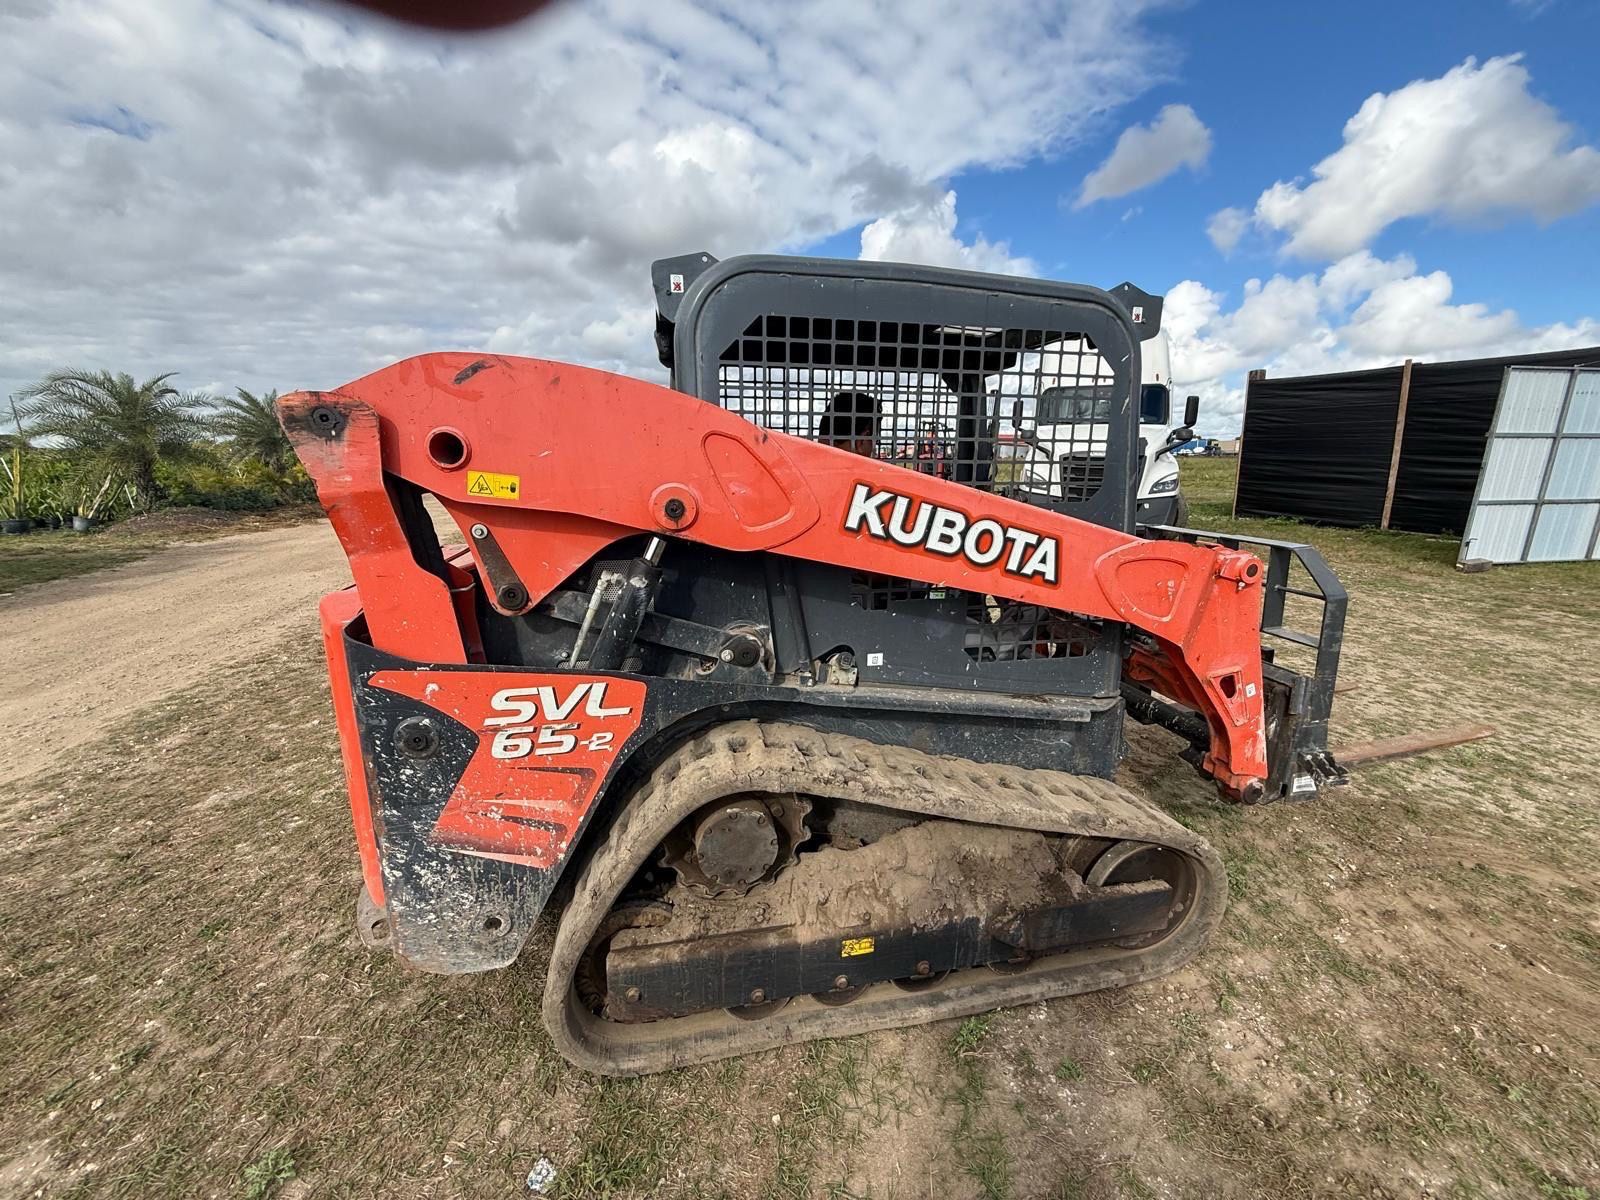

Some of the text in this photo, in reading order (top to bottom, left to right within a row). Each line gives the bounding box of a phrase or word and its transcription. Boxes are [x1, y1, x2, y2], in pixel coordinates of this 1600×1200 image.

[845, 484, 1058, 583] KUBOTA
[483, 682, 632, 726] SVL
[491, 723, 614, 759] 65-2
